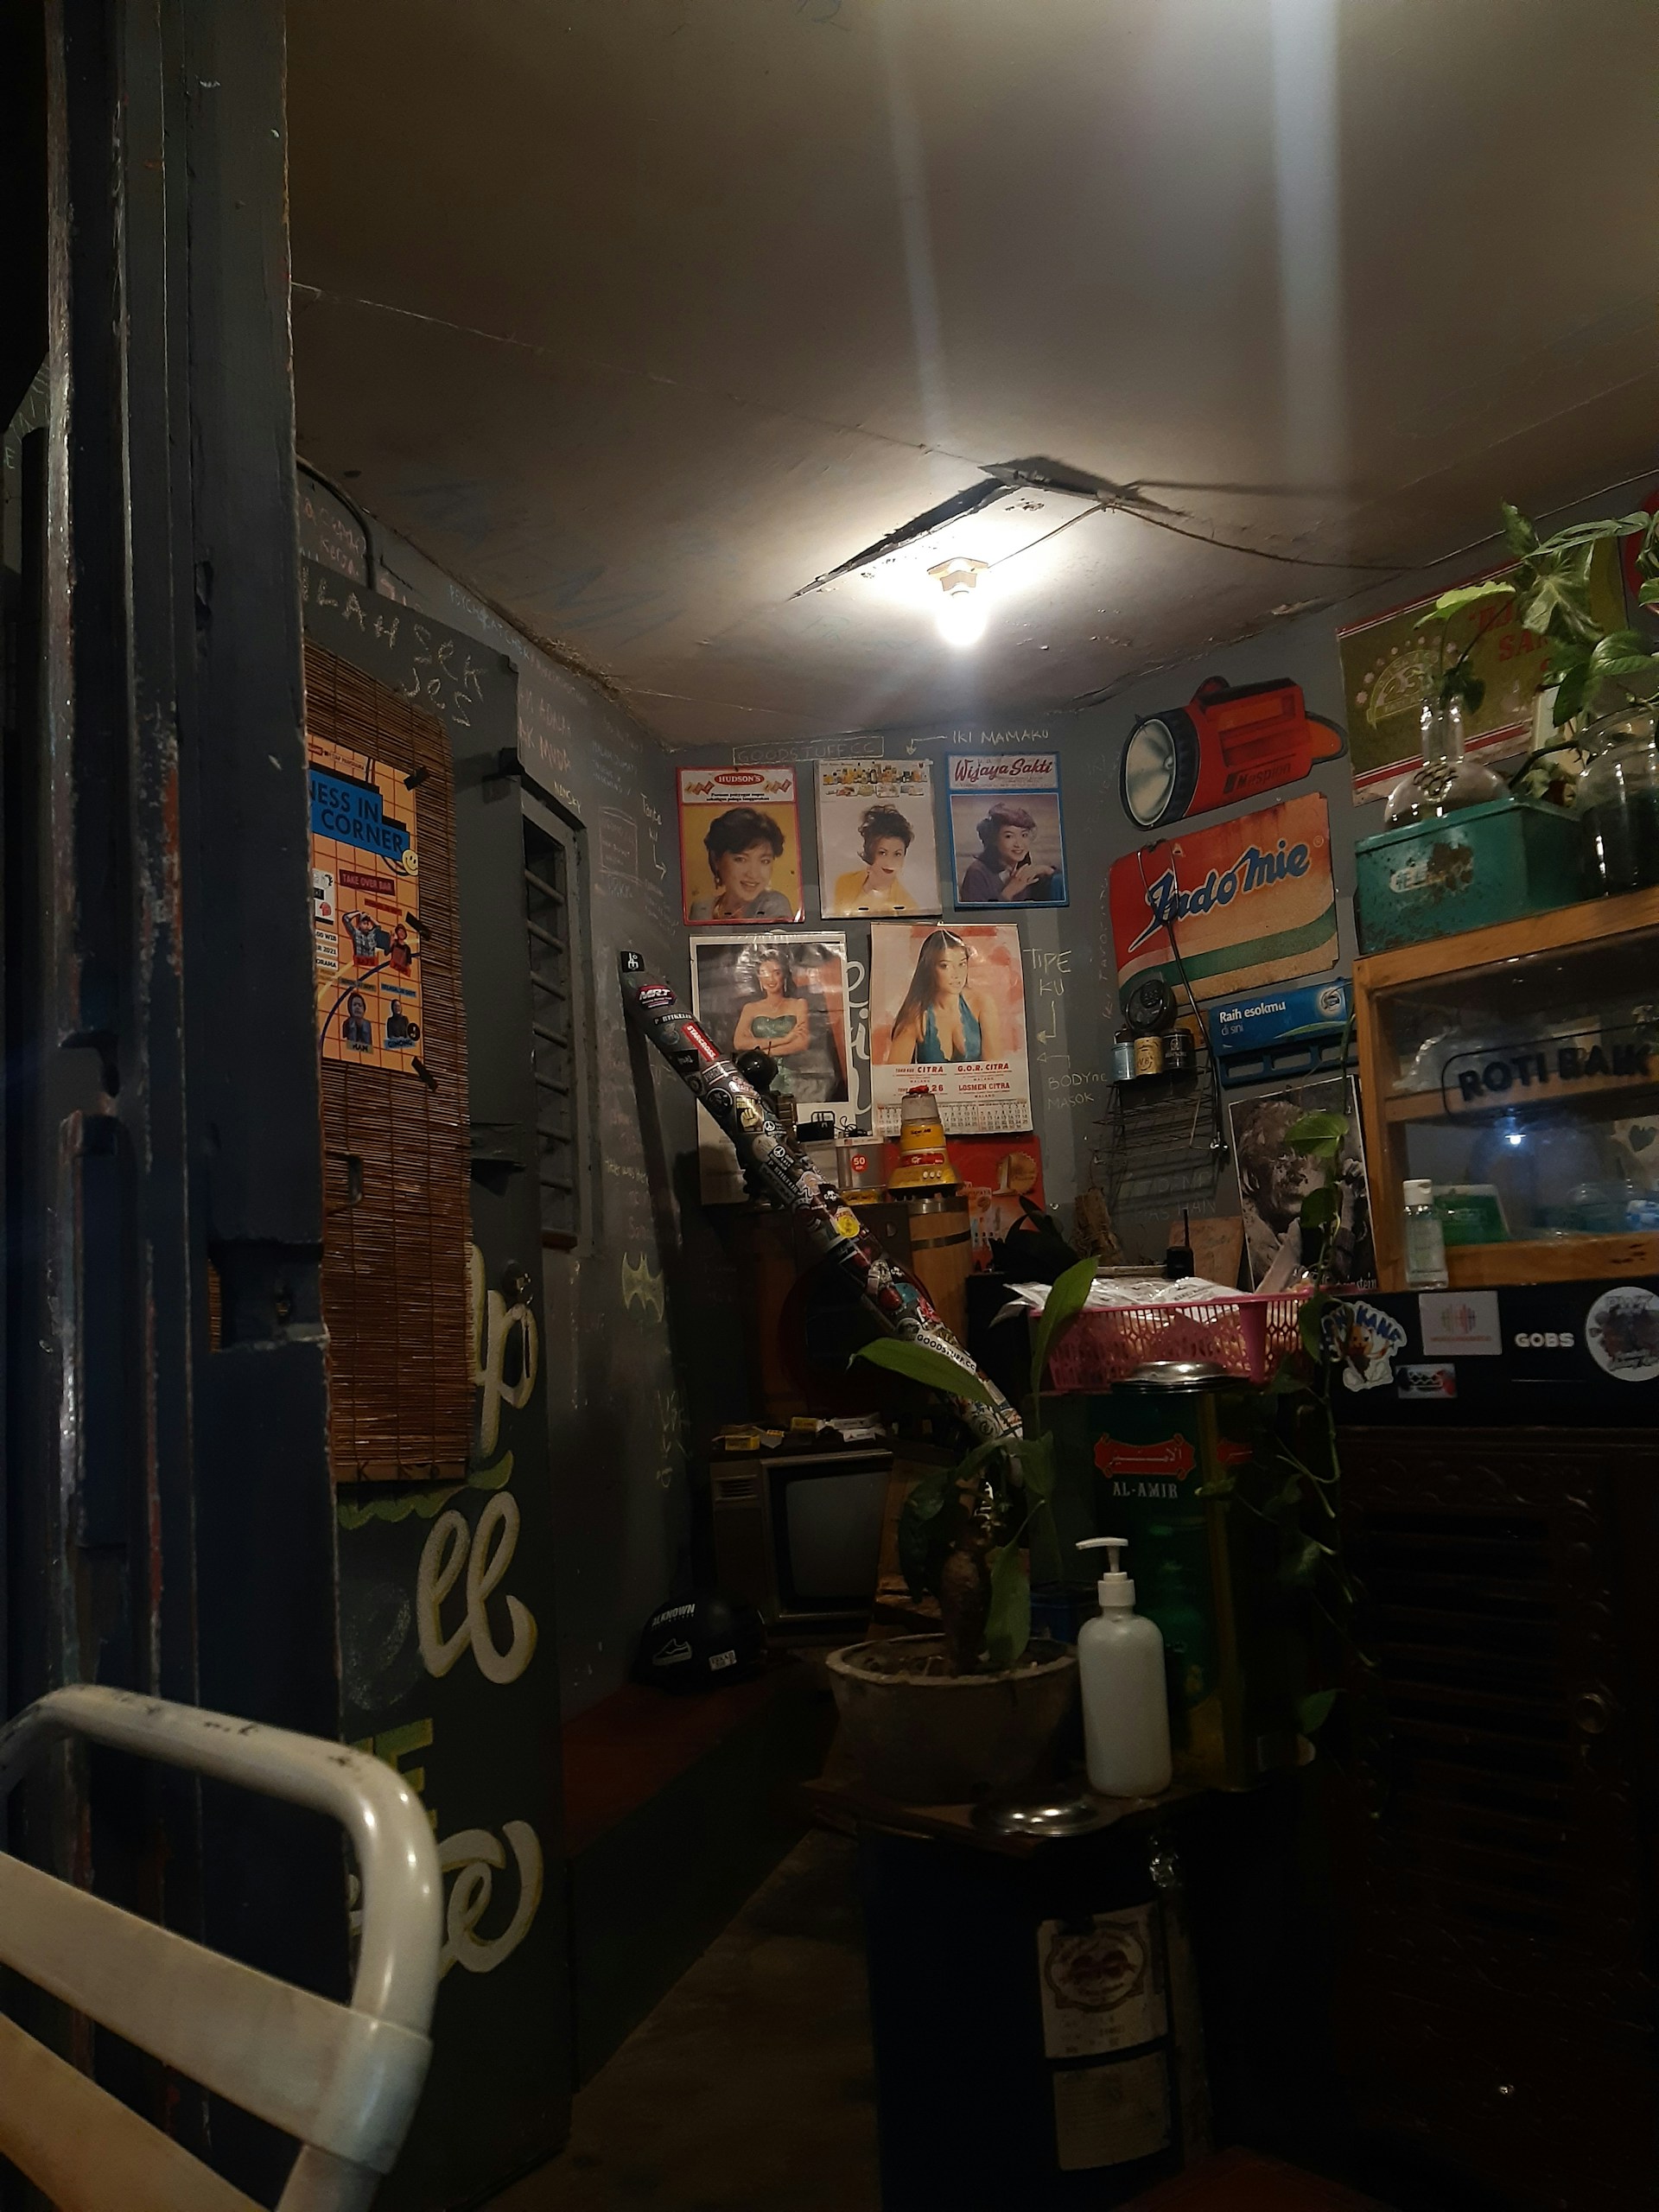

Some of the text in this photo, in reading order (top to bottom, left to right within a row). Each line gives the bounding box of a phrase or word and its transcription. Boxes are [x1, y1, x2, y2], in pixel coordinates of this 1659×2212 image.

[955, 758, 1052, 783] Wijaya Sakti
[359, 797, 379, 823] IN
[321, 808, 403, 853] CORNER
[1039, 978, 1065, 995] KU
[1219, 1001, 1287, 1024] Raih esokmu
[958, 1083, 987, 1091] LOSMEN
[1458, 1052, 1548, 1102] ROTI
[853, 1157, 866, 1166] 50
[1514, 1332, 1576, 1349] GOBS
[1112, 1481, 1179, 1500] AL-AMIR
